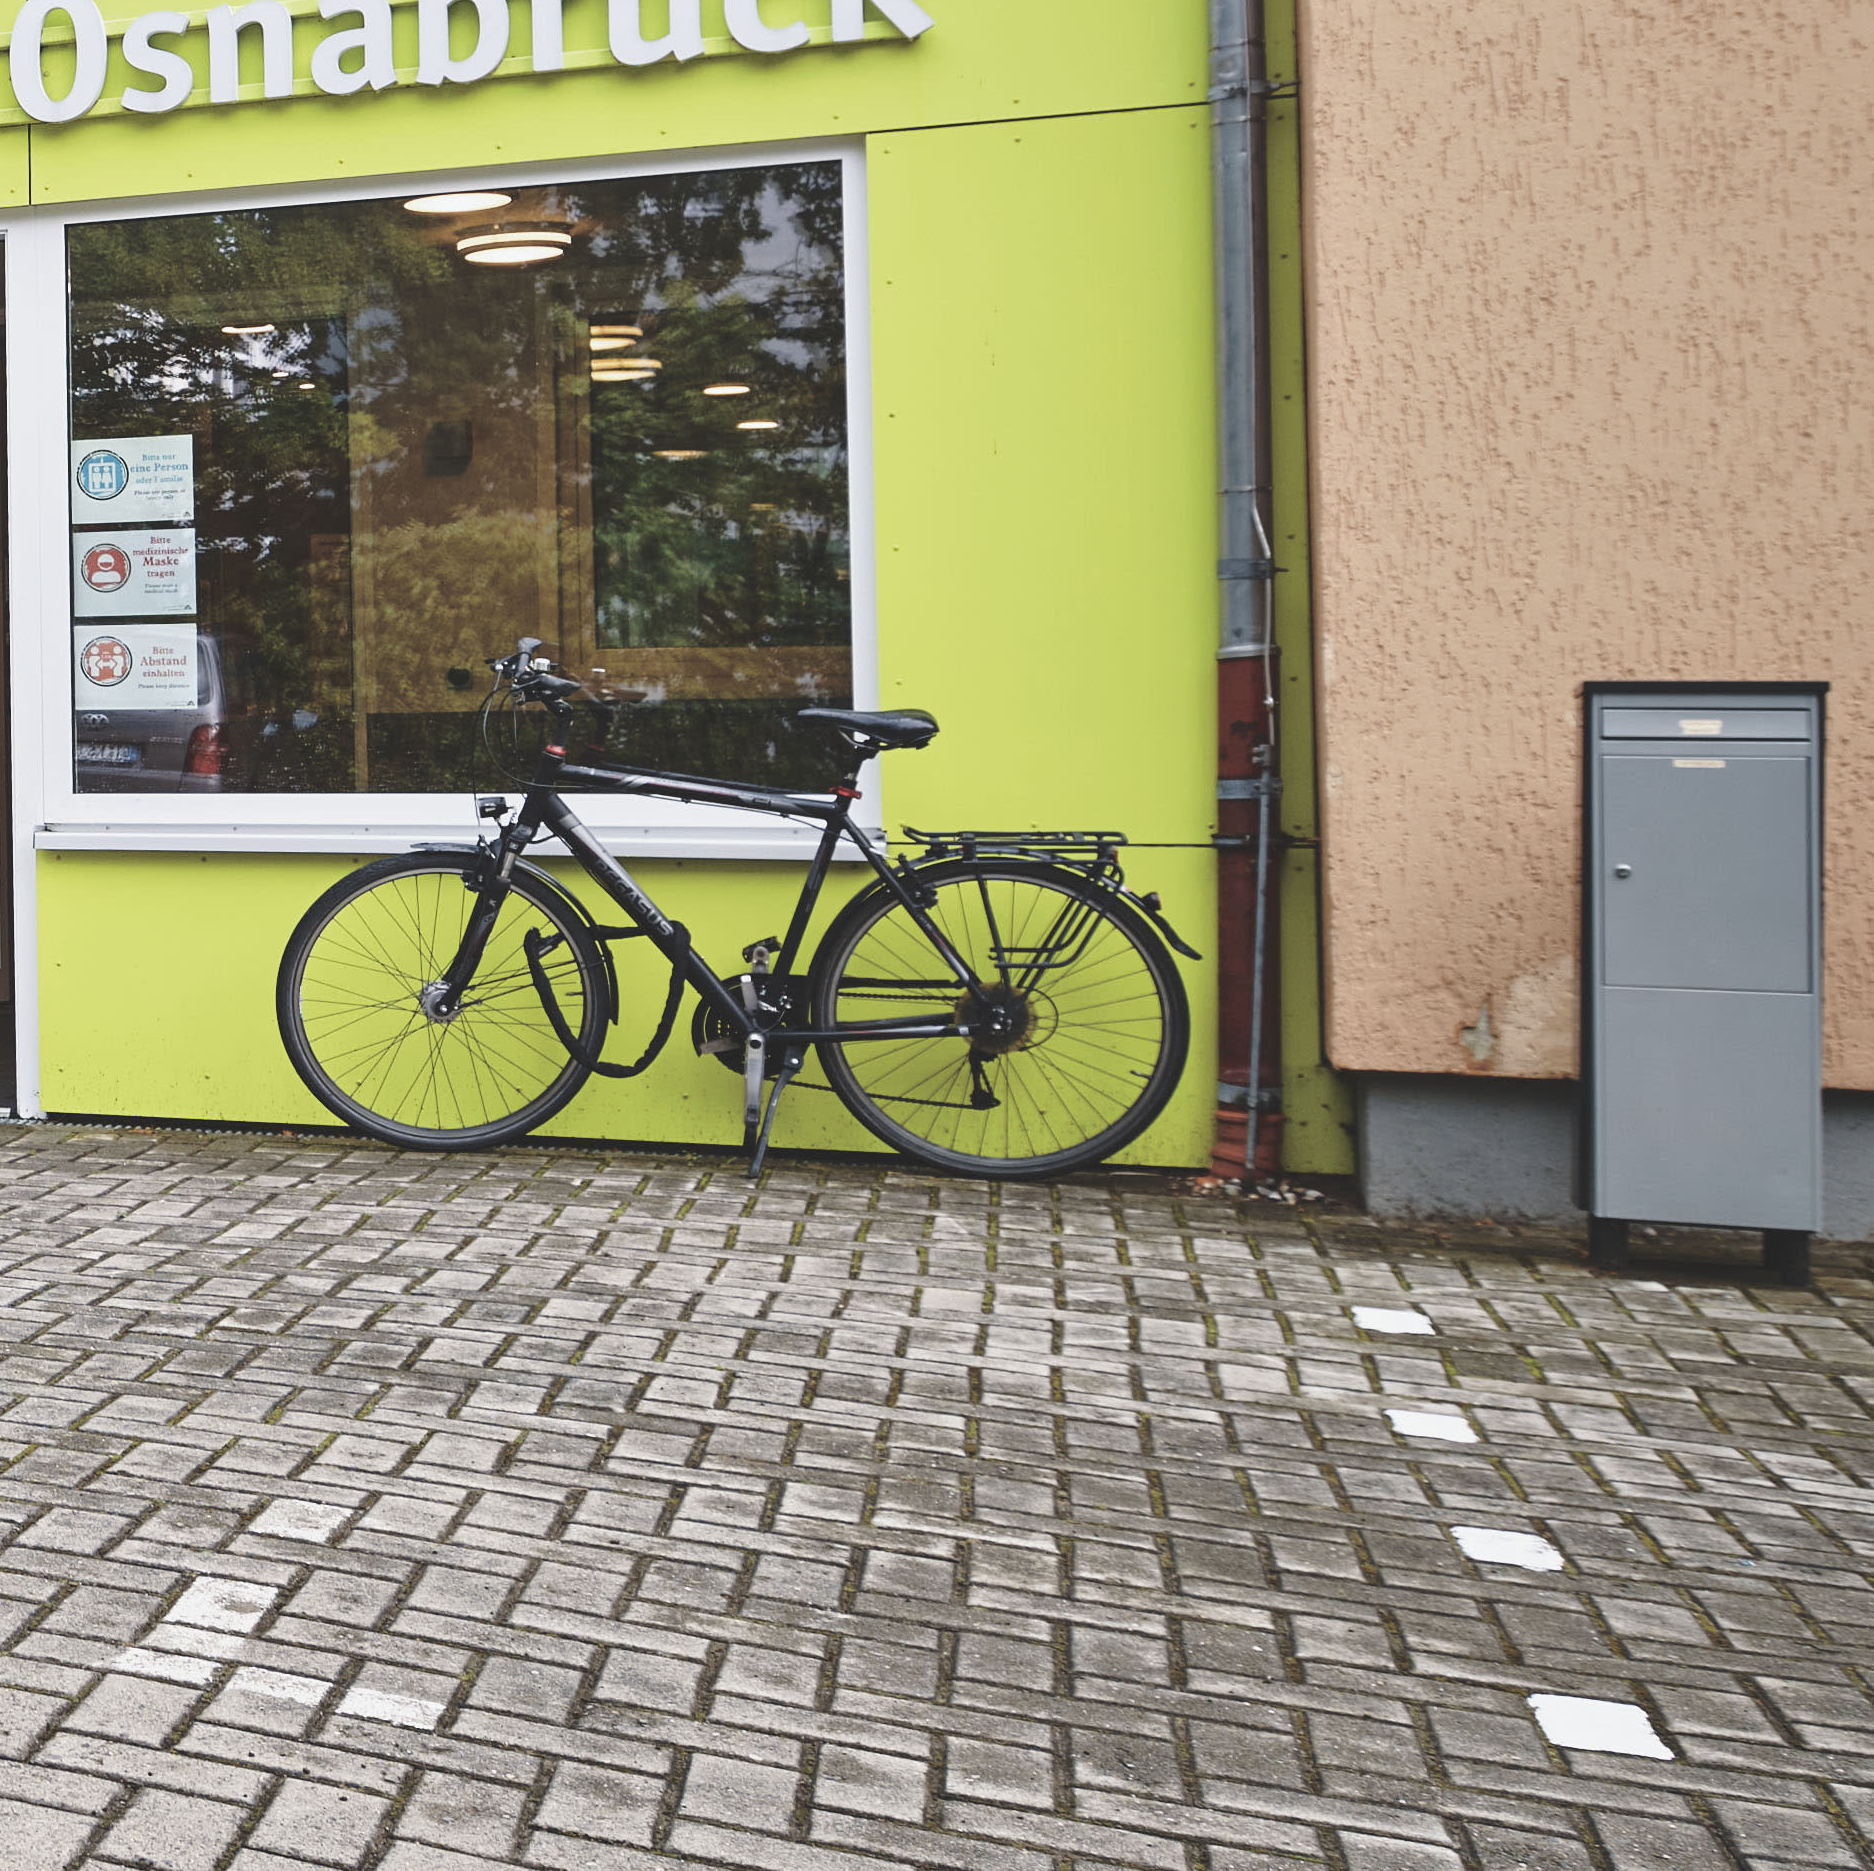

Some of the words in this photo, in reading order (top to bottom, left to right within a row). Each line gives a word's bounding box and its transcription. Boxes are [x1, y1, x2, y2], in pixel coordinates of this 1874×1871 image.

[130, 464, 151, 472] eine
[154, 463, 189, 472] Person
[150, 536, 172, 544] Bitte
[132, 547, 189, 556] medizinische
[143, 556, 179, 566] Maske
[147, 570, 175, 578] tragen
[152, 646, 174, 655] Bitte
[140, 656, 187, 667] Abstand
[142, 668, 185, 678] einhalten
